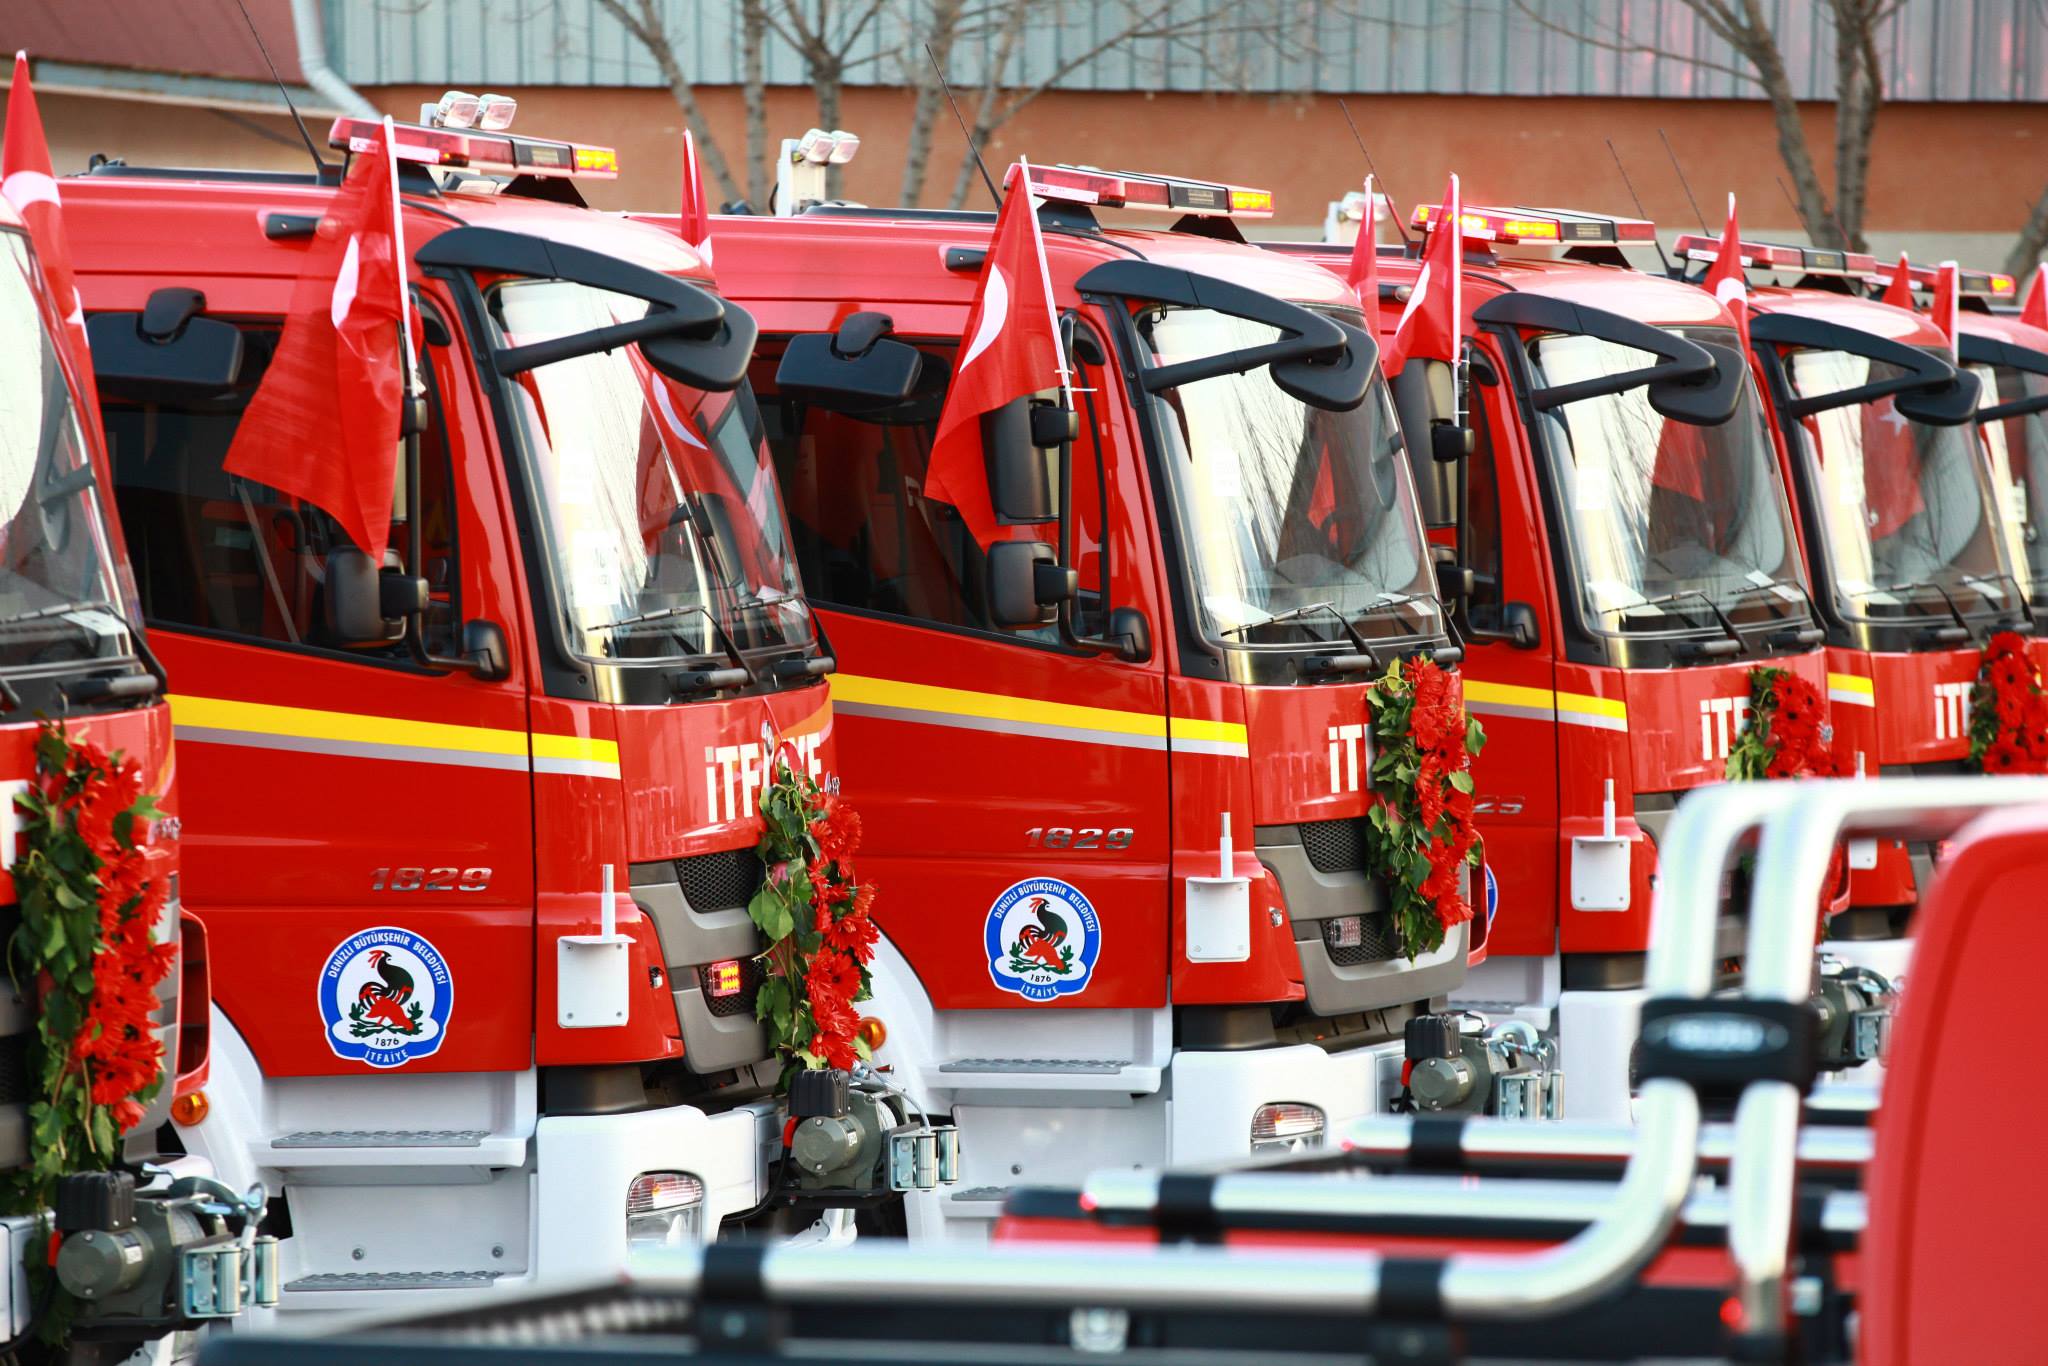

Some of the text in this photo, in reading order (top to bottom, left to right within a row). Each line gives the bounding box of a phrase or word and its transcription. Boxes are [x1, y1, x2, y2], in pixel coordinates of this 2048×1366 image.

[1025, 827, 1134, 849] 1829
[369, 867, 492, 891] 1829
[994, 889, 1018, 919] DENİZLİ
[1018, 880, 1067, 896] BÜYÜKŞEHİR
[328, 931, 448, 985] DENİZLİ BÜYÜKŞEHİR BELEDİYESİ
[1030, 974, 1052, 983] 1876
[1020, 983, 1059, 997] İTFAİYE
[375, 1037, 400, 1047] 1876
[364, 1048, 409, 1063] İTFAİYE
